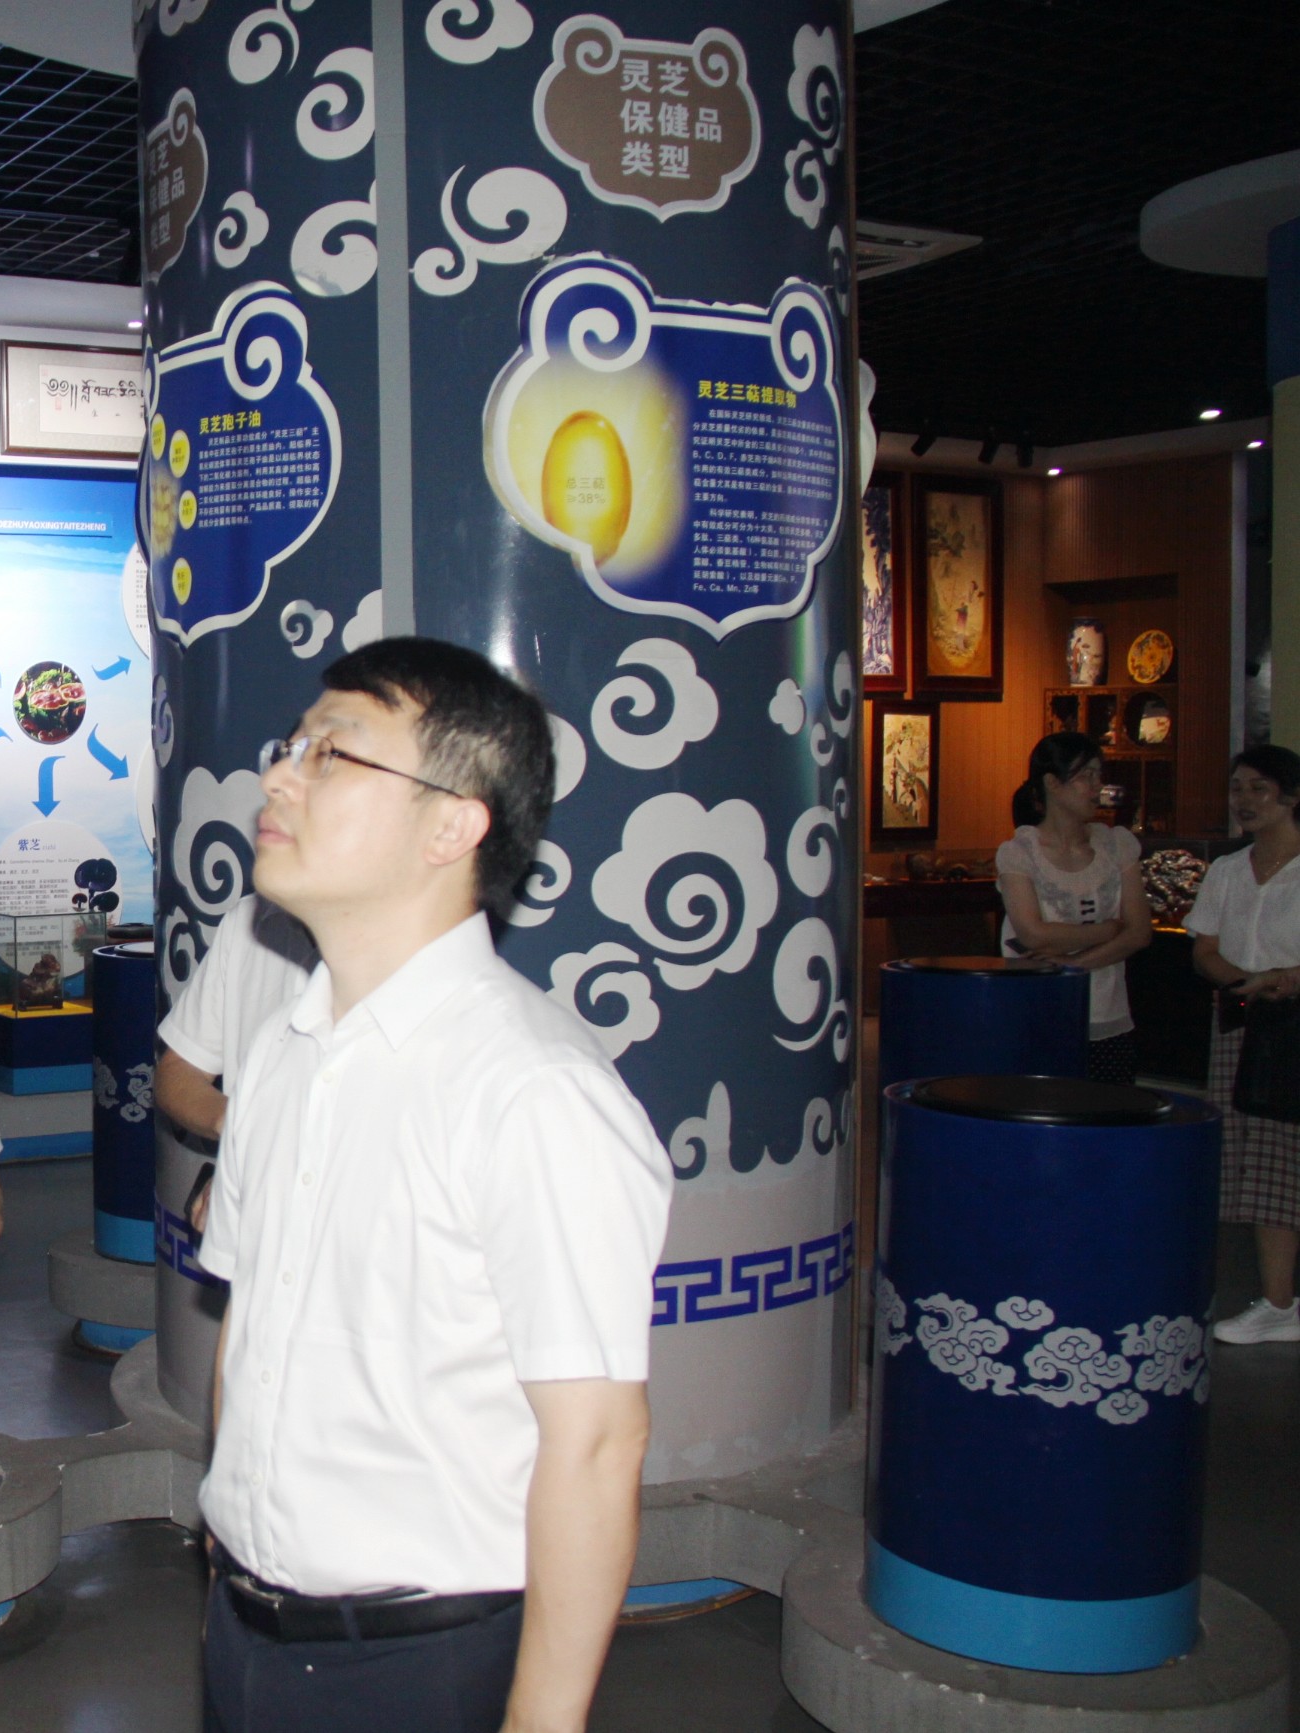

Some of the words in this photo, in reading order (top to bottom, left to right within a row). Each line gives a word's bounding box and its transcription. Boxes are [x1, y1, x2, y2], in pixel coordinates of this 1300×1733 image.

[620, 58, 690, 97] 灵芝
[620, 99, 723, 144] 保健品
[621, 141, 692, 180] 类型
[698, 380, 797, 408] 灵芝三萜提取物
[199, 409, 262, 435] 灵芝孢子油
[566, 477, 605, 489] 总三萜
[18, 838, 41, 852] 紫芝
